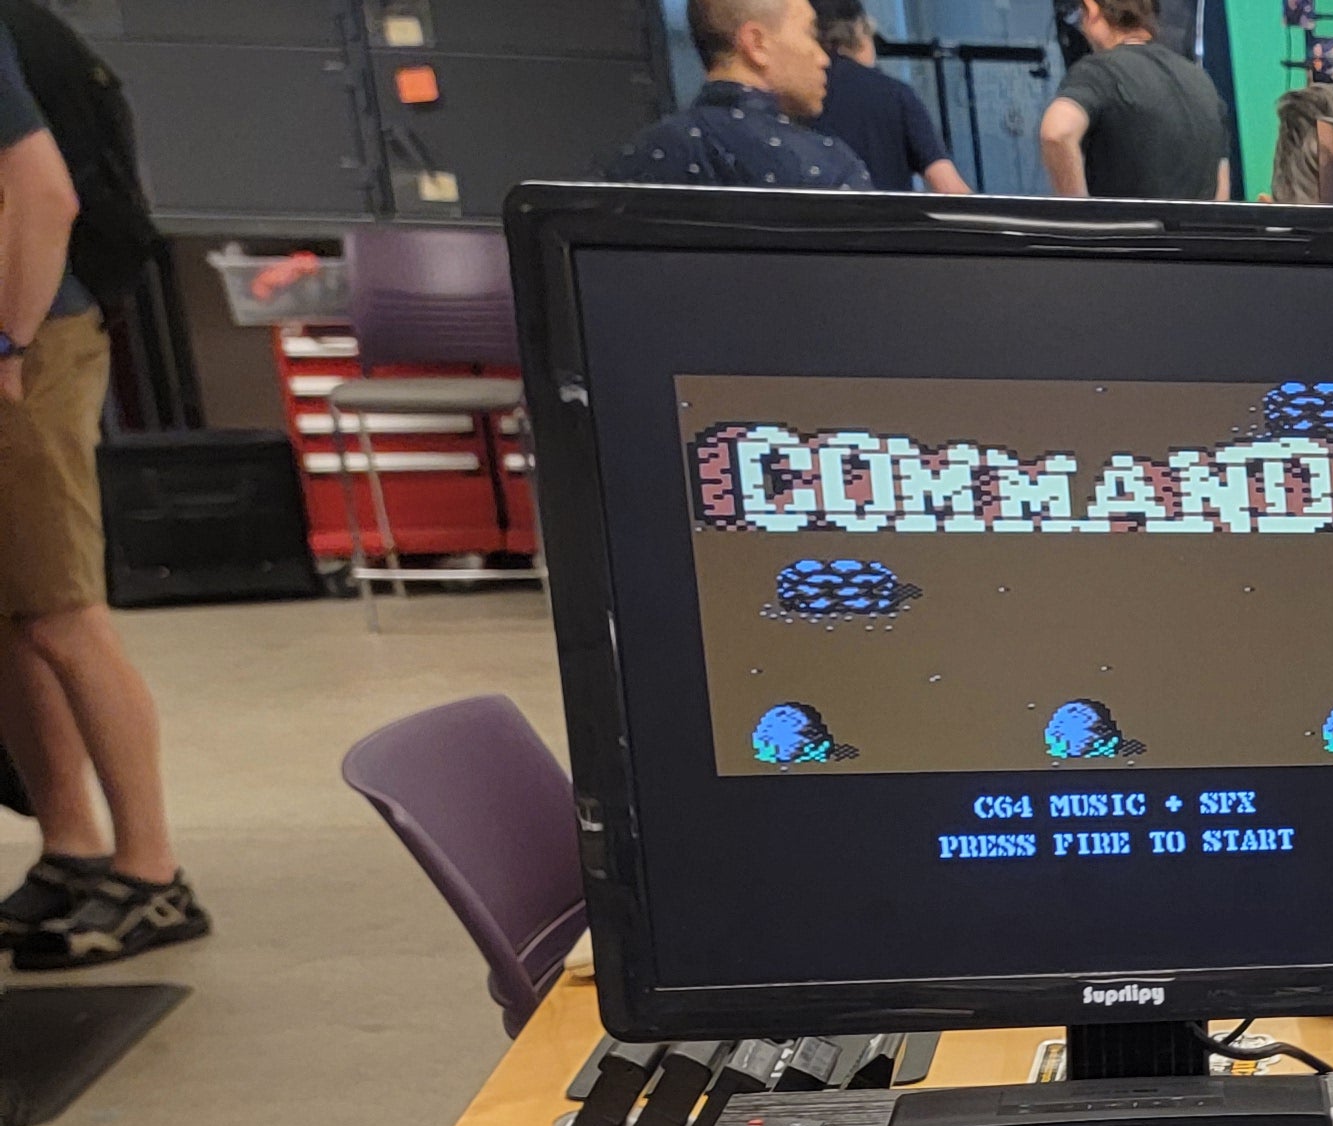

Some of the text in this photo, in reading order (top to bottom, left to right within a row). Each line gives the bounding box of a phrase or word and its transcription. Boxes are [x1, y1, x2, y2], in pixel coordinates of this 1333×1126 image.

[974, 791, 1257, 819] C64 MUSIC + SFX
[938, 828, 1294, 859] PRESS FIRE TO START
